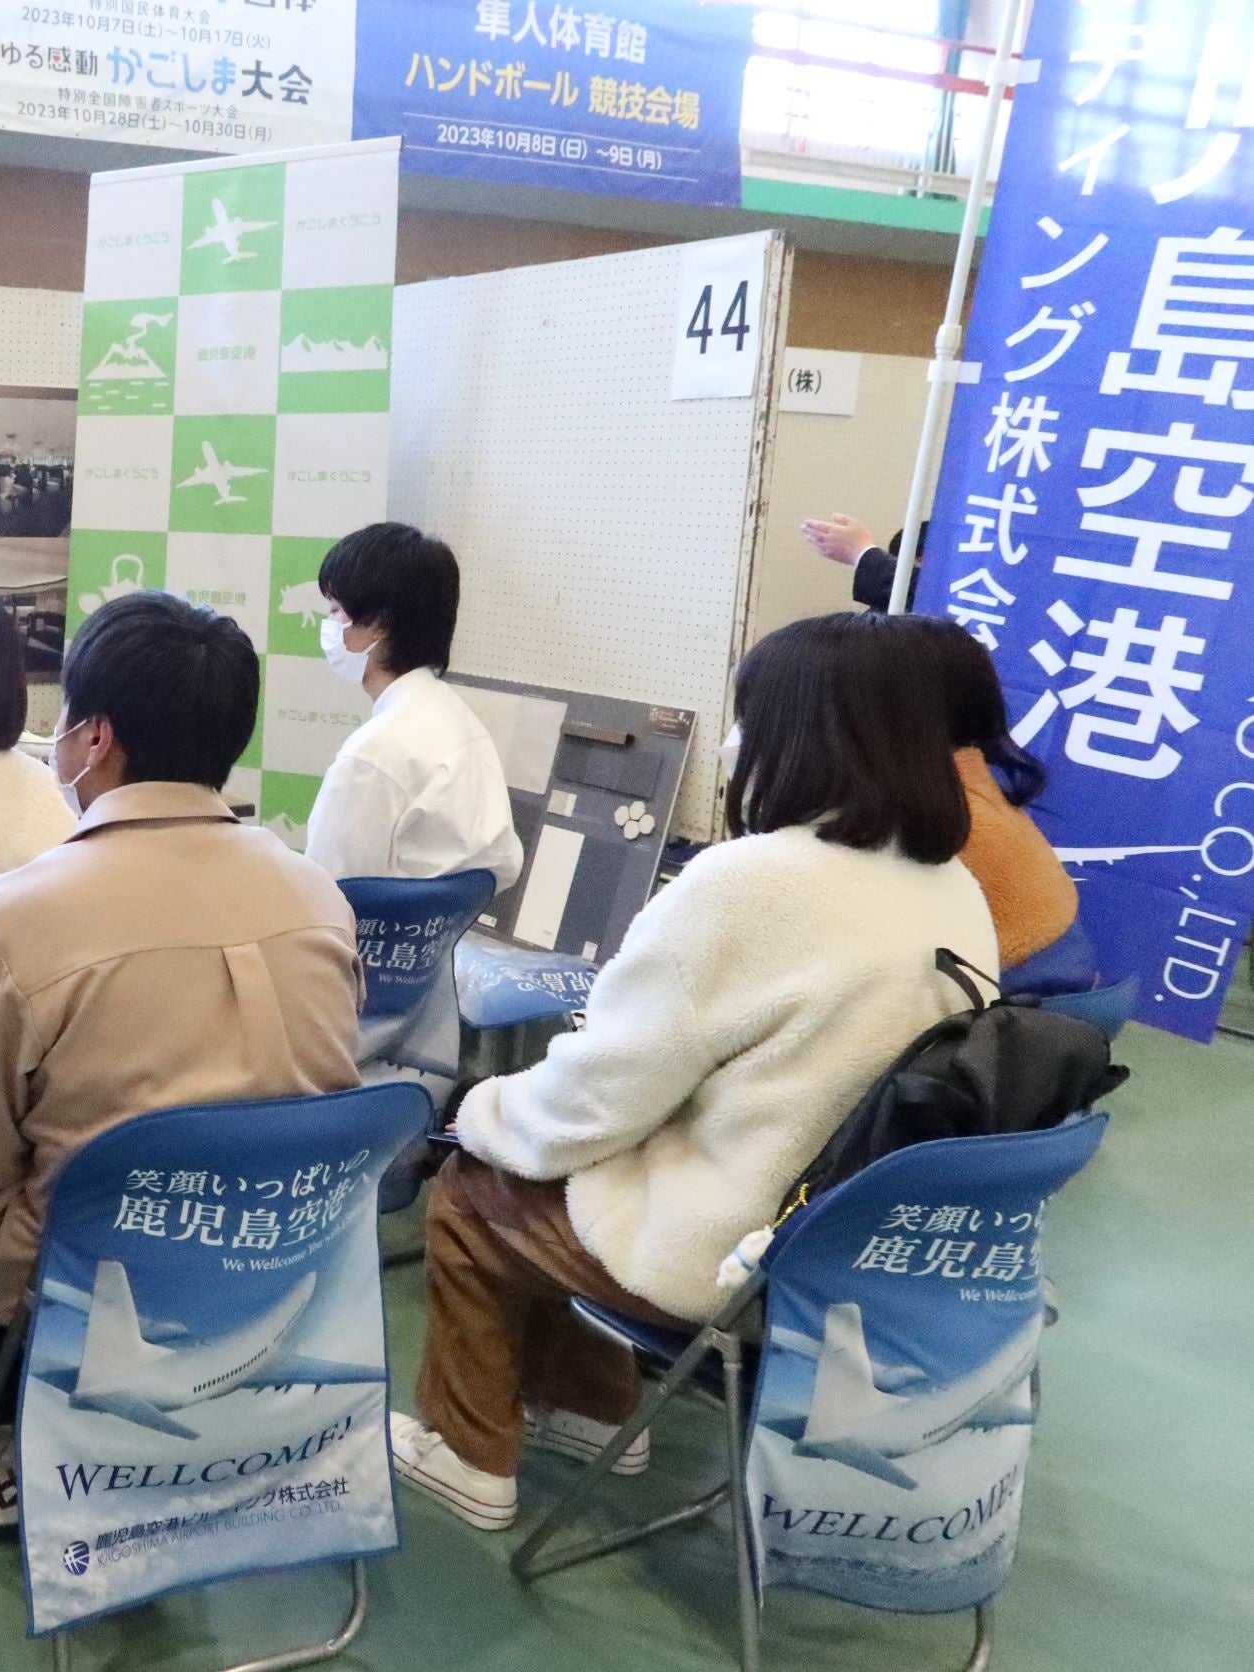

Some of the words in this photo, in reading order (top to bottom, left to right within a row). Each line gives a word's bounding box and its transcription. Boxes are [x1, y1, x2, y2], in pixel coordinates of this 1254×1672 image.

[474, 0, 648, 65] 隼人体育館
[106, 45, 313, 105] かごしま大会
[405, 52, 579, 108] ハンドボール
[588, 74, 701, 131] 競技会場
[57, 87, 239, 120] 特別全国障害者スポーツ大会
[686, 280, 750, 355] 44
[125, 1149, 370, 1199] 笑顔いっぱいの
[221, 1257, 246, 1272] We
[959, 1288, 981, 1302] We
[224, 1509, 286, 1531] BUILDING
